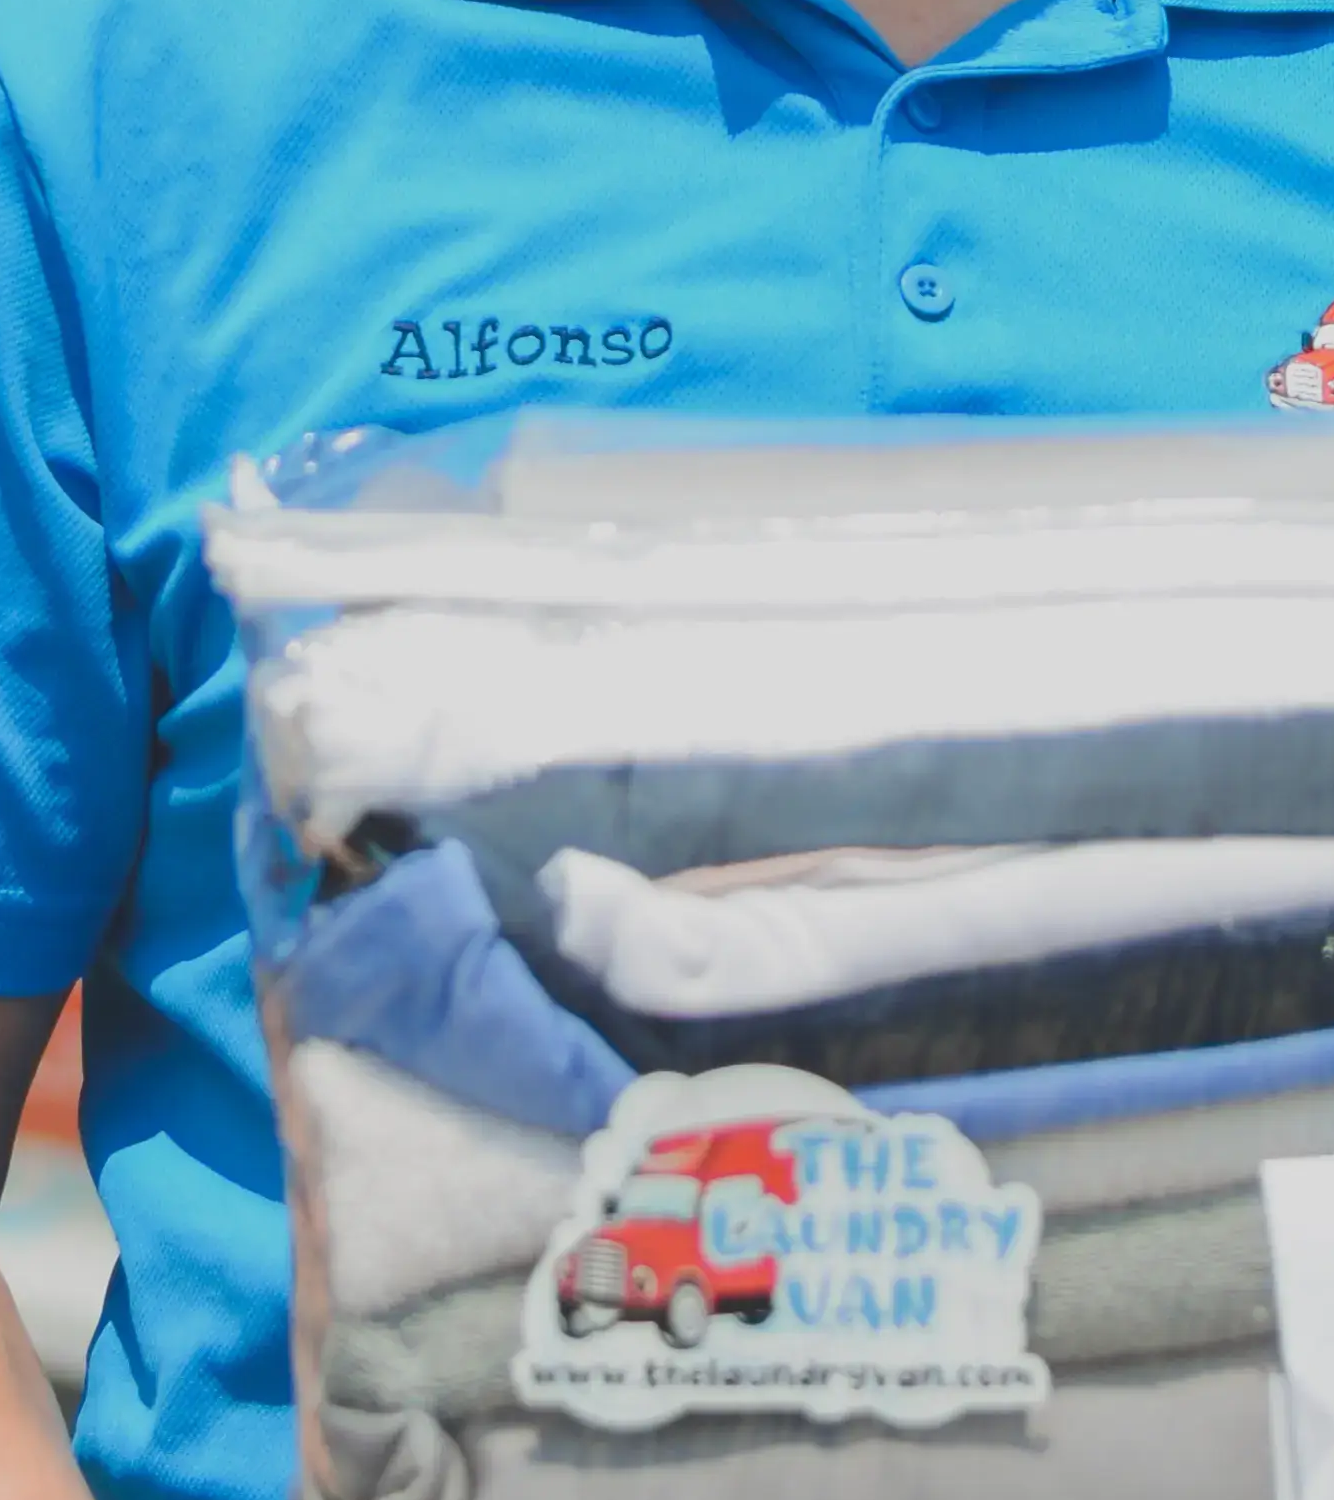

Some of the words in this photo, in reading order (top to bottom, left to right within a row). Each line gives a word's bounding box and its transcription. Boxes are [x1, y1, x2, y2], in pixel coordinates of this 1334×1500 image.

[379, 315, 673, 381] Alfonso
[789, 1132, 941, 1193] THE
[709, 1203, 1024, 1262] LAUNDRY
[783, 1273, 939, 1330] VAN
